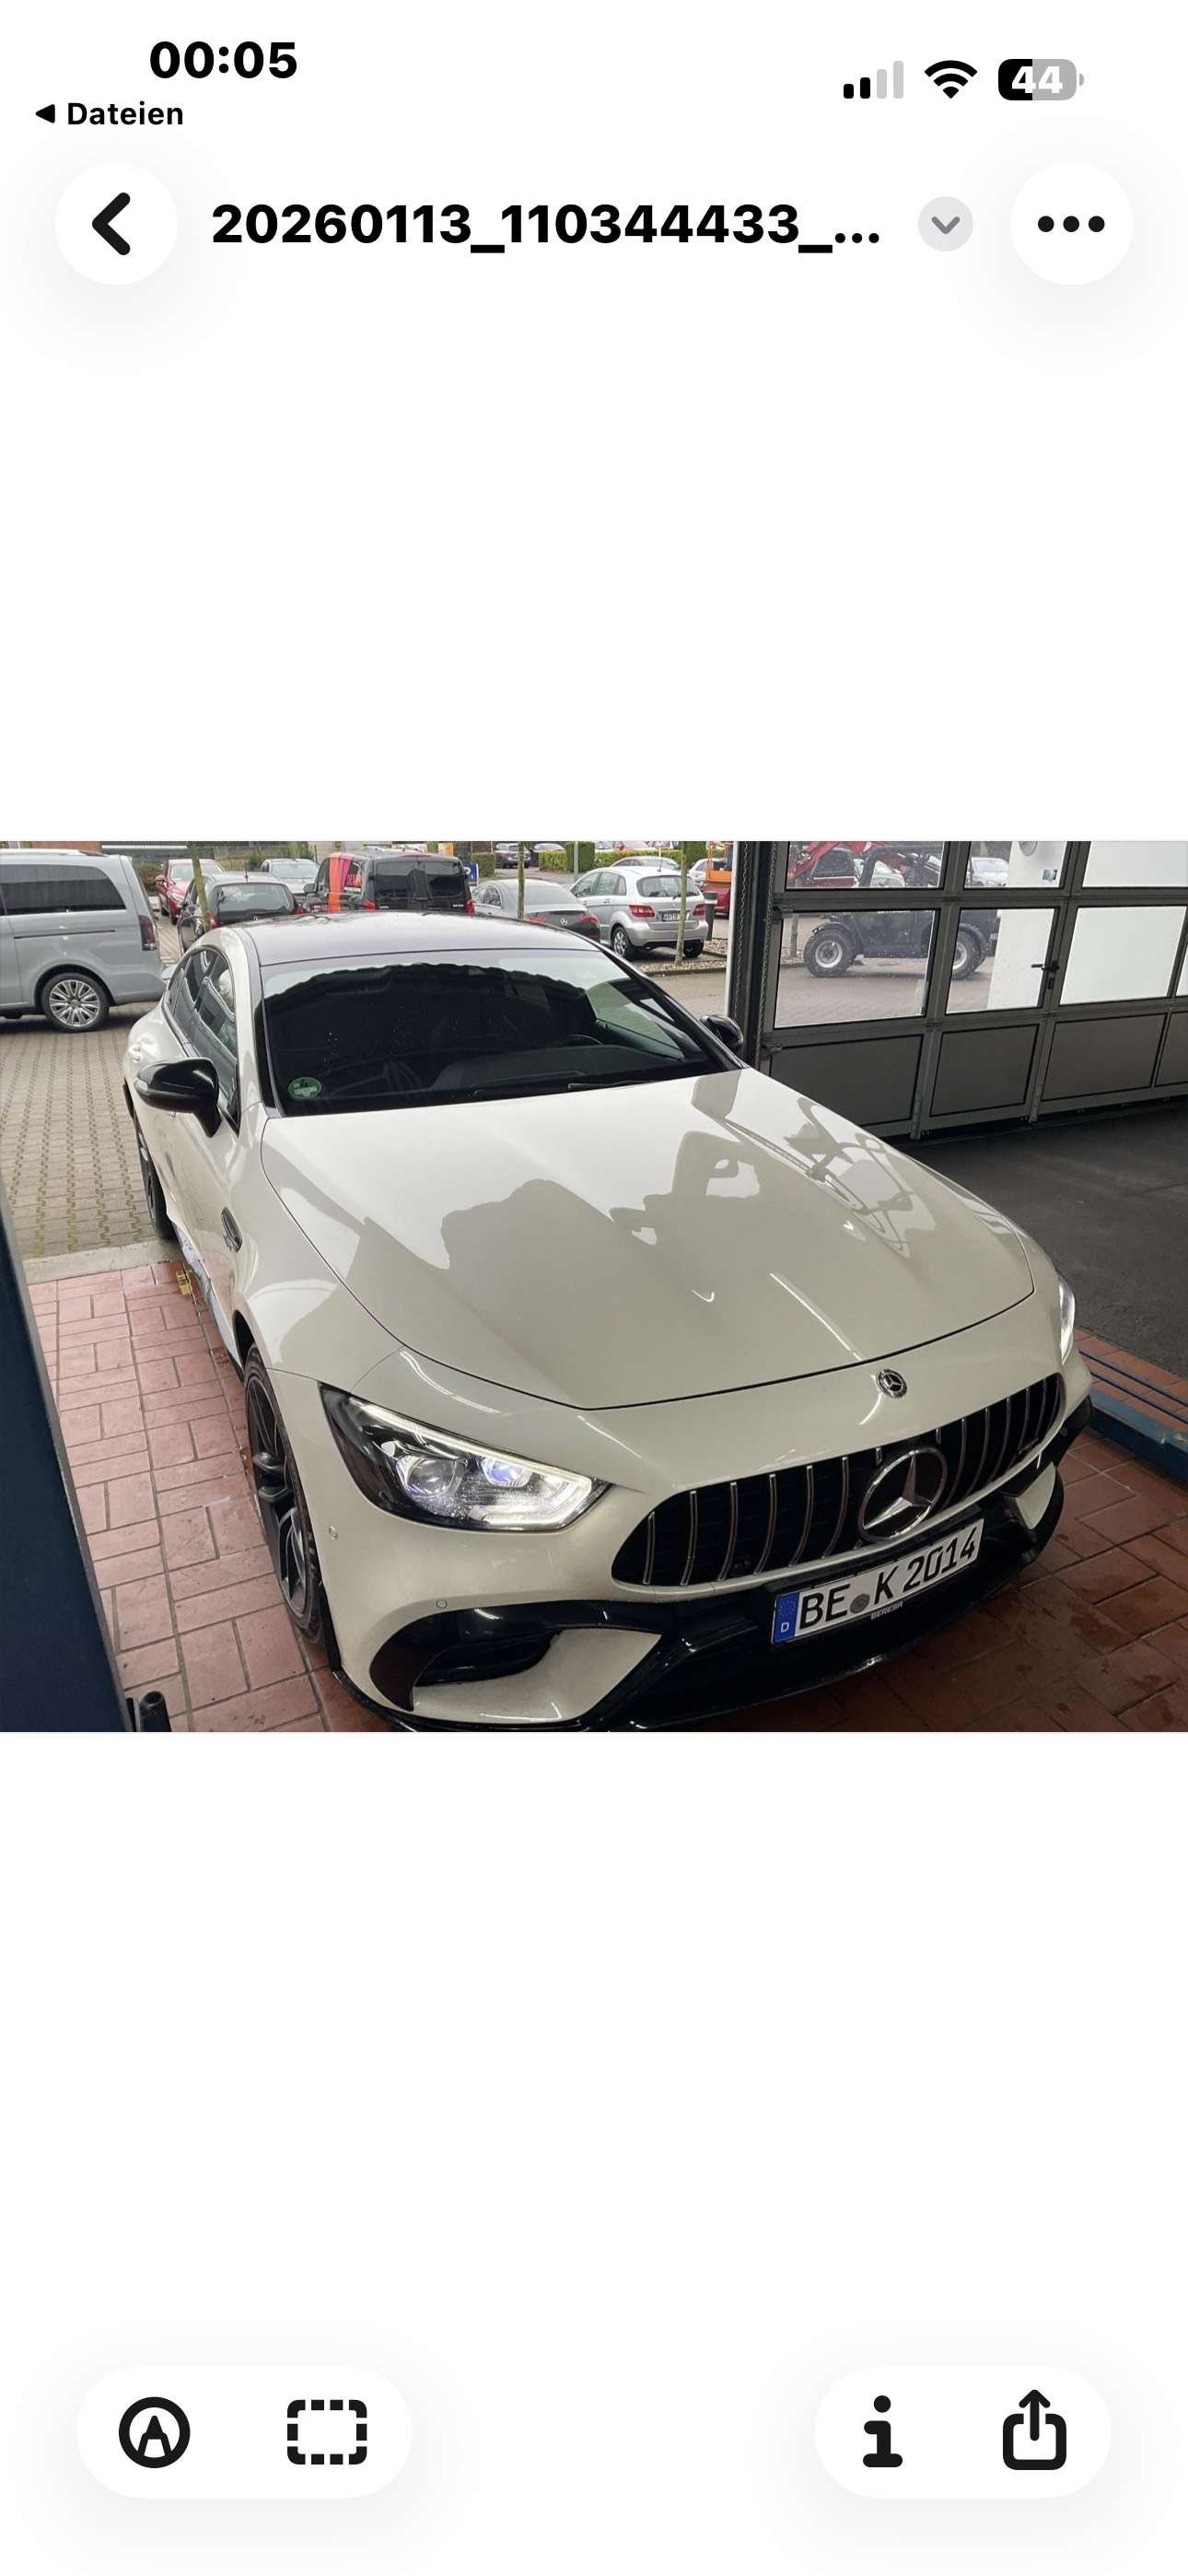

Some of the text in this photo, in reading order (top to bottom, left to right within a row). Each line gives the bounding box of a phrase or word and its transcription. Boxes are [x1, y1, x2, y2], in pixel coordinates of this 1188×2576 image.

[799, 1526, 977, 1630] BE K 2014
[781, 1622, 789, 1633] D
